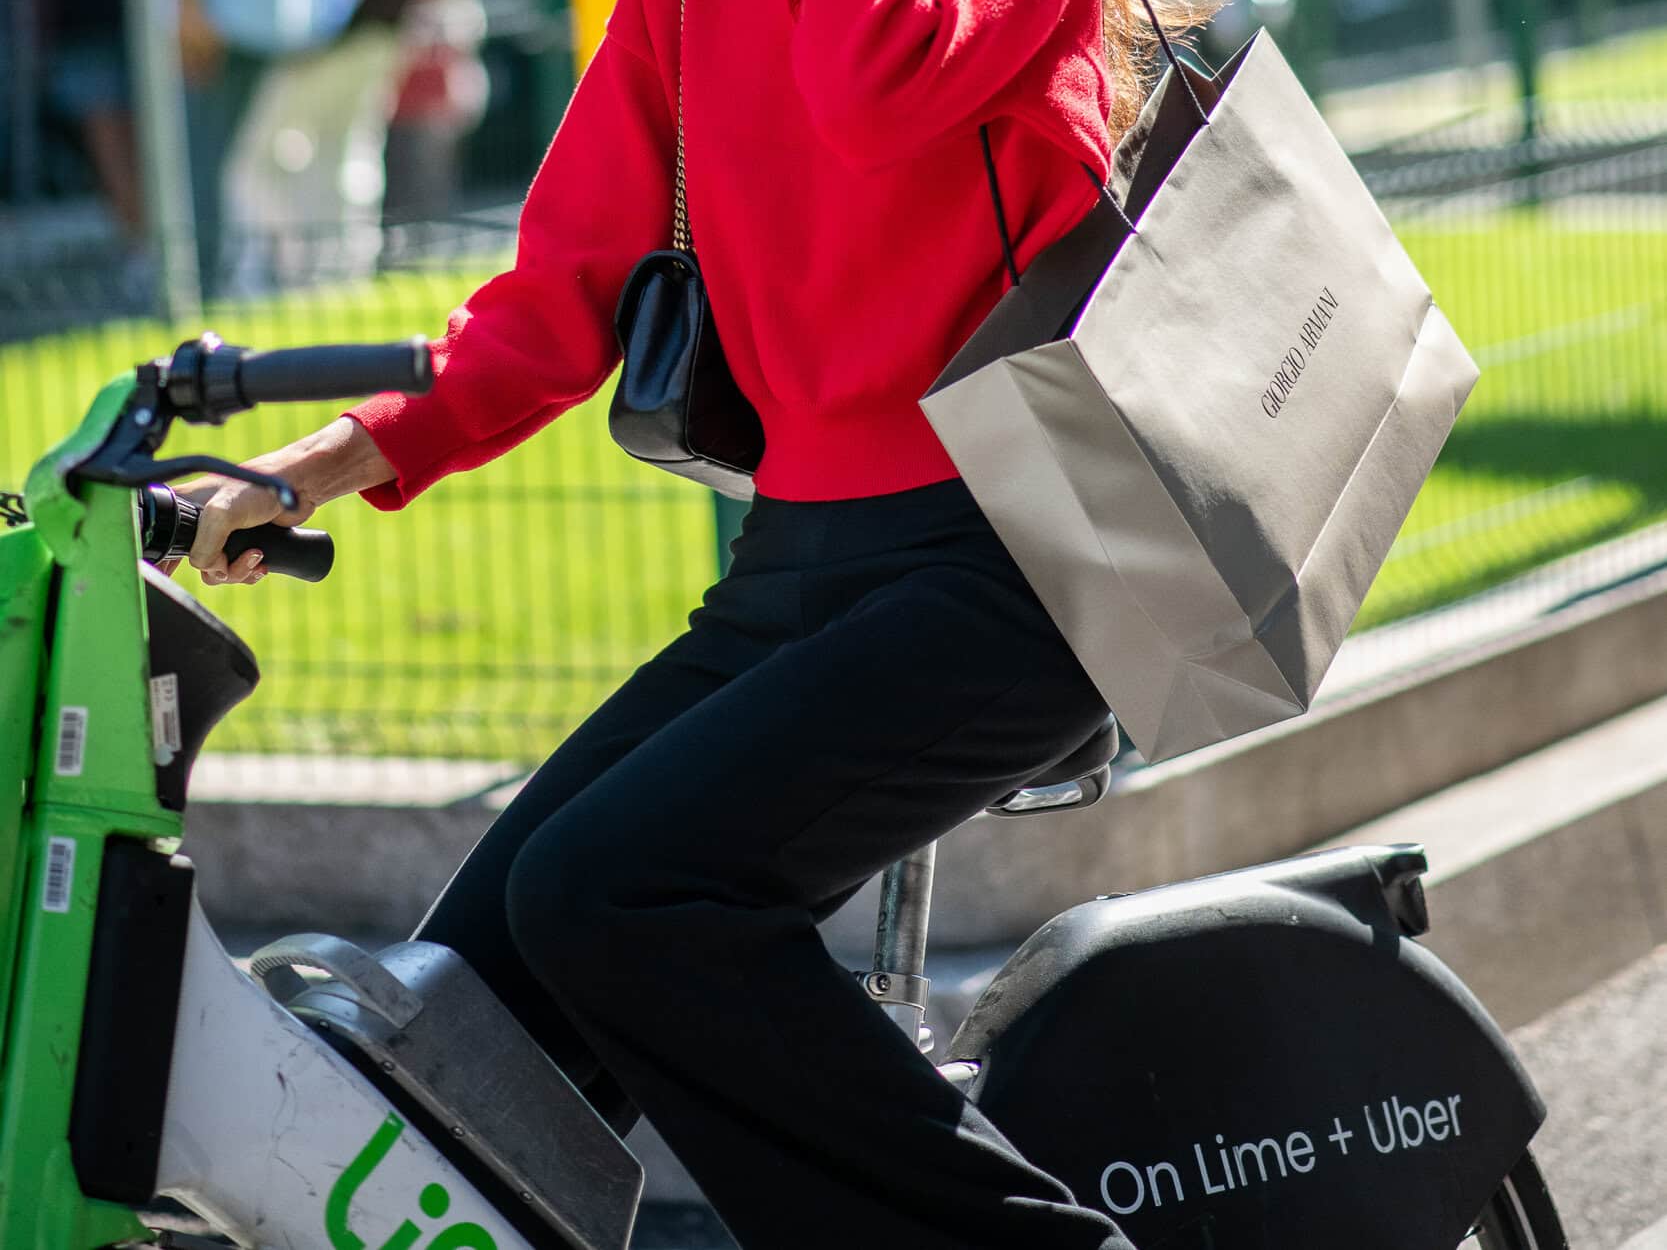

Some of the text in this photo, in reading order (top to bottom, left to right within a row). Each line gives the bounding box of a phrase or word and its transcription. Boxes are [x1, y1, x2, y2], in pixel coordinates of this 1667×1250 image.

[1261, 286, 1339, 419] GIORGIO ARMANI
[1100, 1161, 1184, 1215] On
[1194, 1131, 1316, 1195] Lime
[1364, 1094, 1461, 1154] Uber
